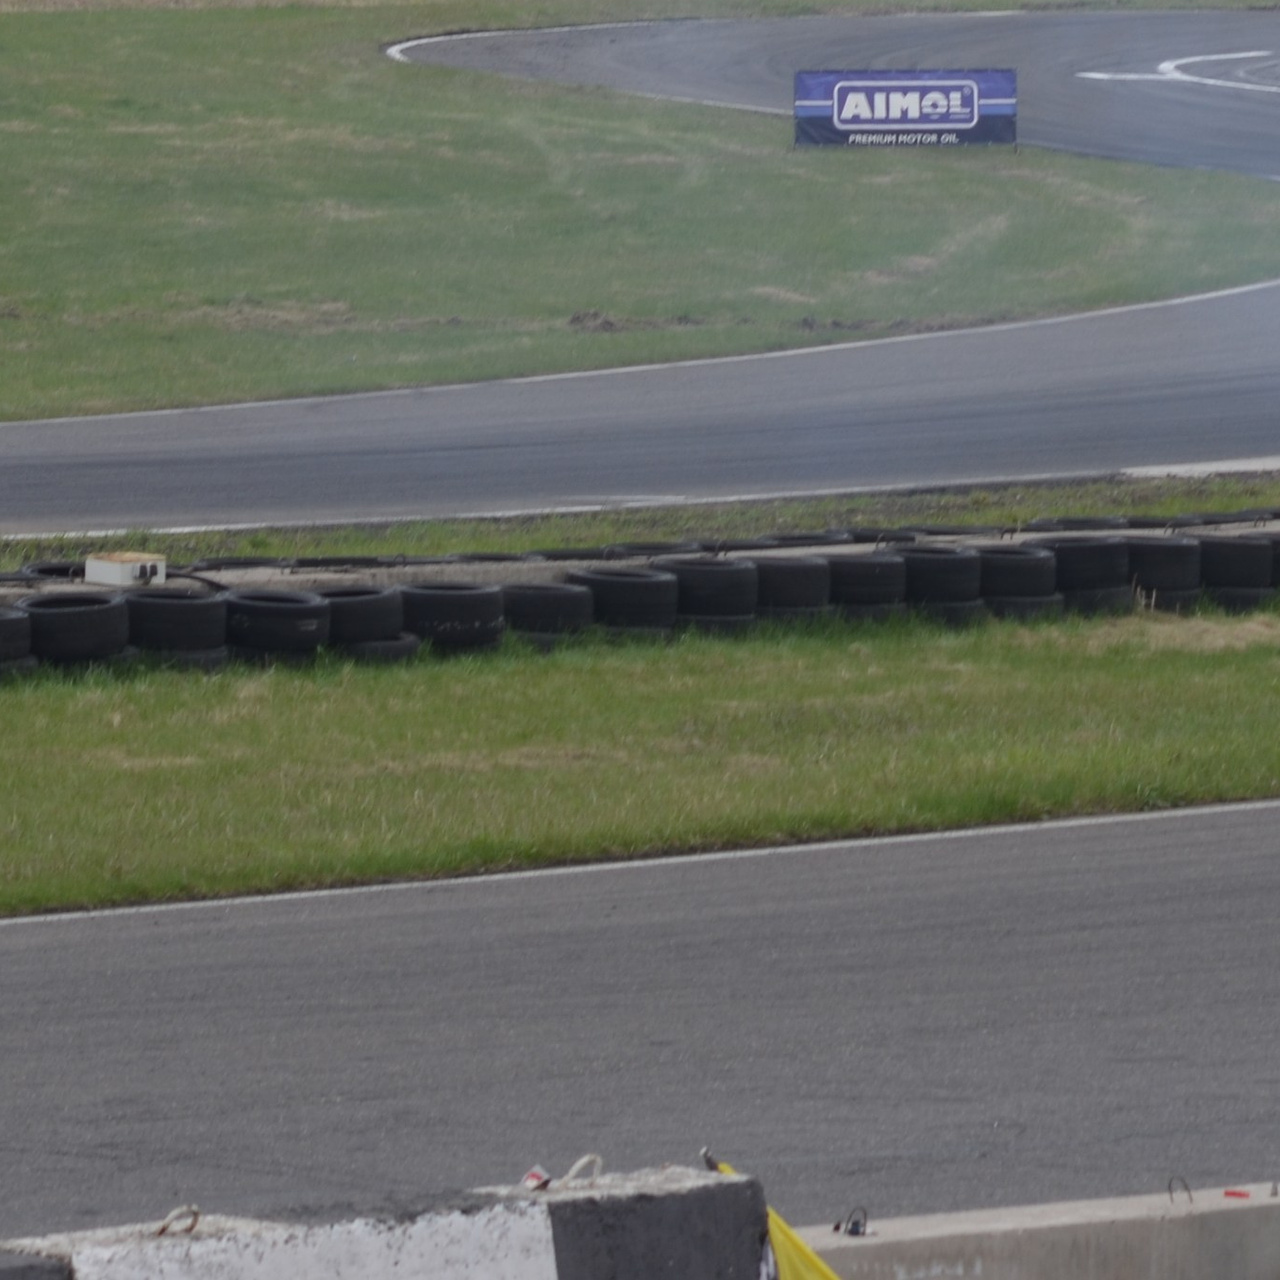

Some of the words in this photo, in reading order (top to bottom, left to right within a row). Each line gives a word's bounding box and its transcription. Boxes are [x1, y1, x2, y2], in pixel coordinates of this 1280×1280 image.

[839, 90, 972, 120] AIMOL
[848, 133, 896, 145] PREMIUM
[898, 133, 938, 144] MOTOR
[940, 133, 960, 144] OIL
